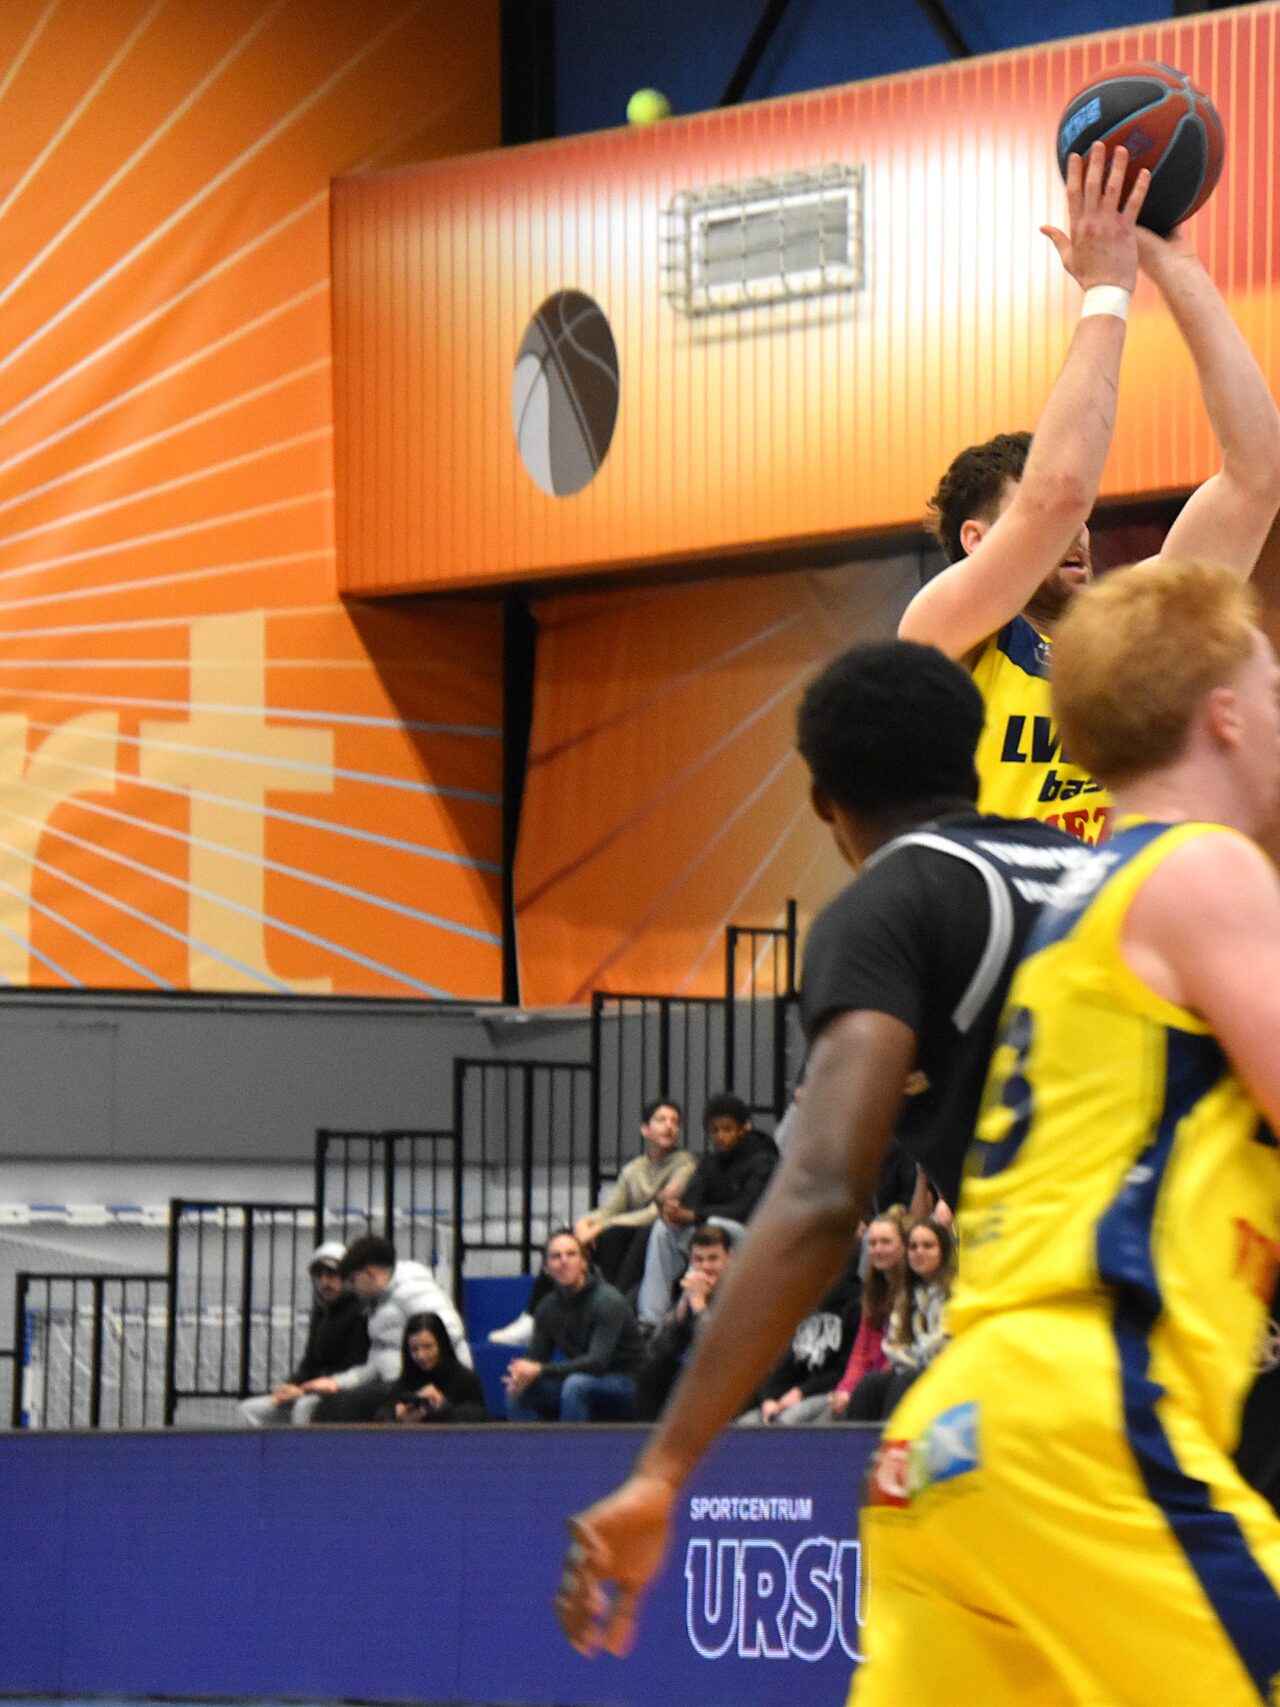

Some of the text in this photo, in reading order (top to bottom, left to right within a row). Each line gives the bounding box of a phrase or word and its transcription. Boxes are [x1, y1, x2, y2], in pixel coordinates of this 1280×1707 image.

[1037, 770, 1106, 802] bas
[690, 1498, 813, 1521] SPORTCENTRUM
[684, 1535, 871, 1662] URSU
